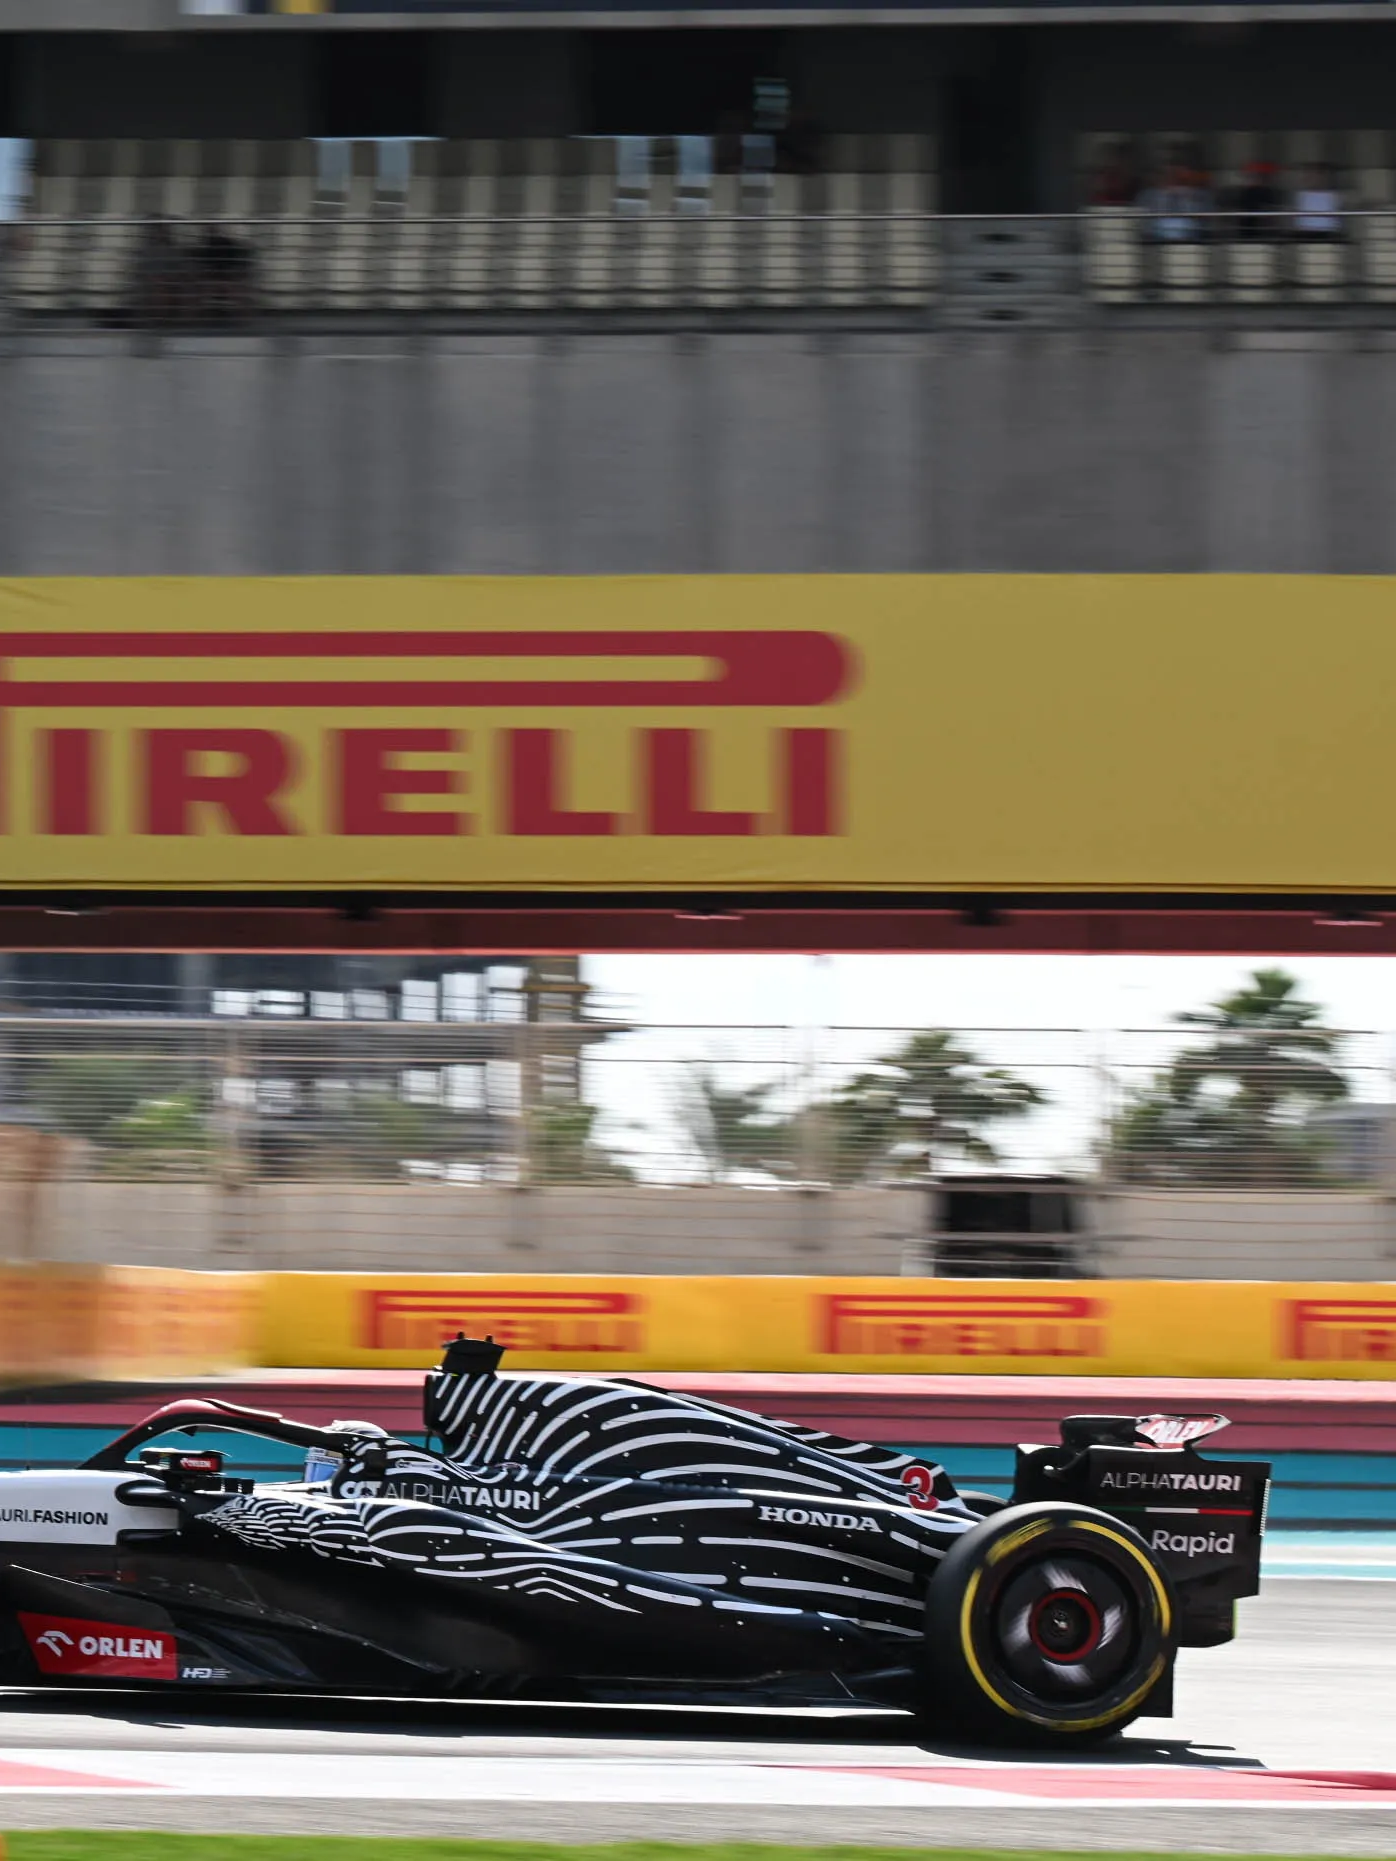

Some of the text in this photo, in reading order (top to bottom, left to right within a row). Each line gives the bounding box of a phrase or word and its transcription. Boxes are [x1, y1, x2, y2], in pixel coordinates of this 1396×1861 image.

[900, 1465, 940, 1512] 3
[1100, 1472, 1242, 1491] ALPHATAURI
[758, 1506, 883, 1533] HONDA
[1152, 1530, 1234, 1557] Rapid
[79, 1636, 163, 1659] ORLEN
